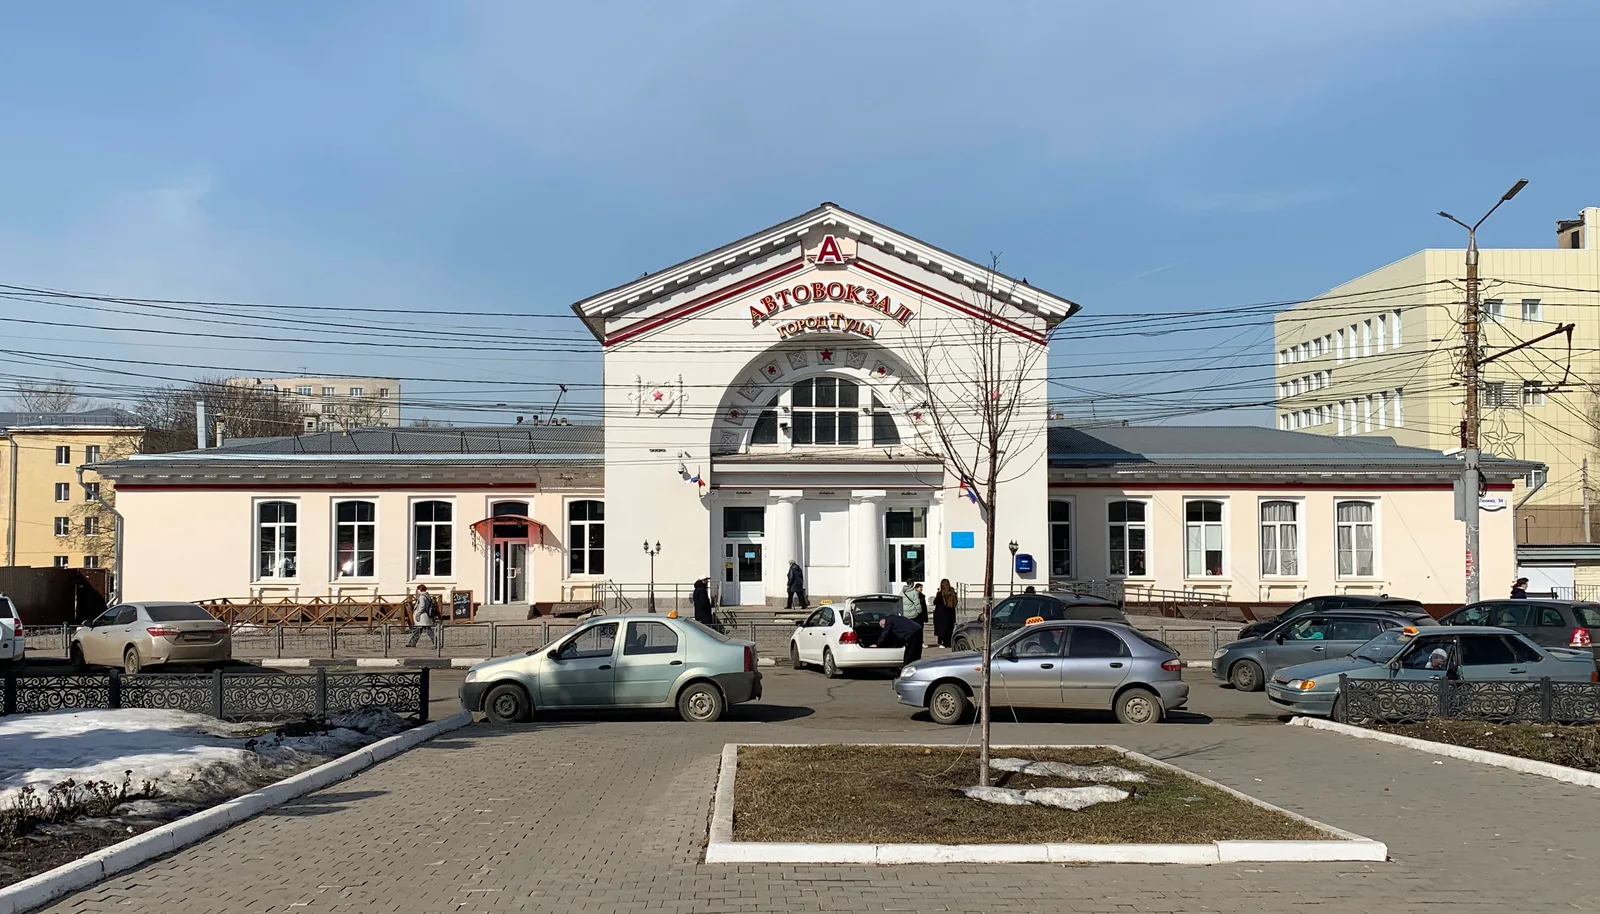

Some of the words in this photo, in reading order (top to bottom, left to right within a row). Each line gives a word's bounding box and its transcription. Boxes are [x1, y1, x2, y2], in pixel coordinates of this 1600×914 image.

[815, 234, 845, 264] А
[749, 282, 914, 326] АВТОВОКЗАЛ
[776, 315, 829, 340] ГОРОД
